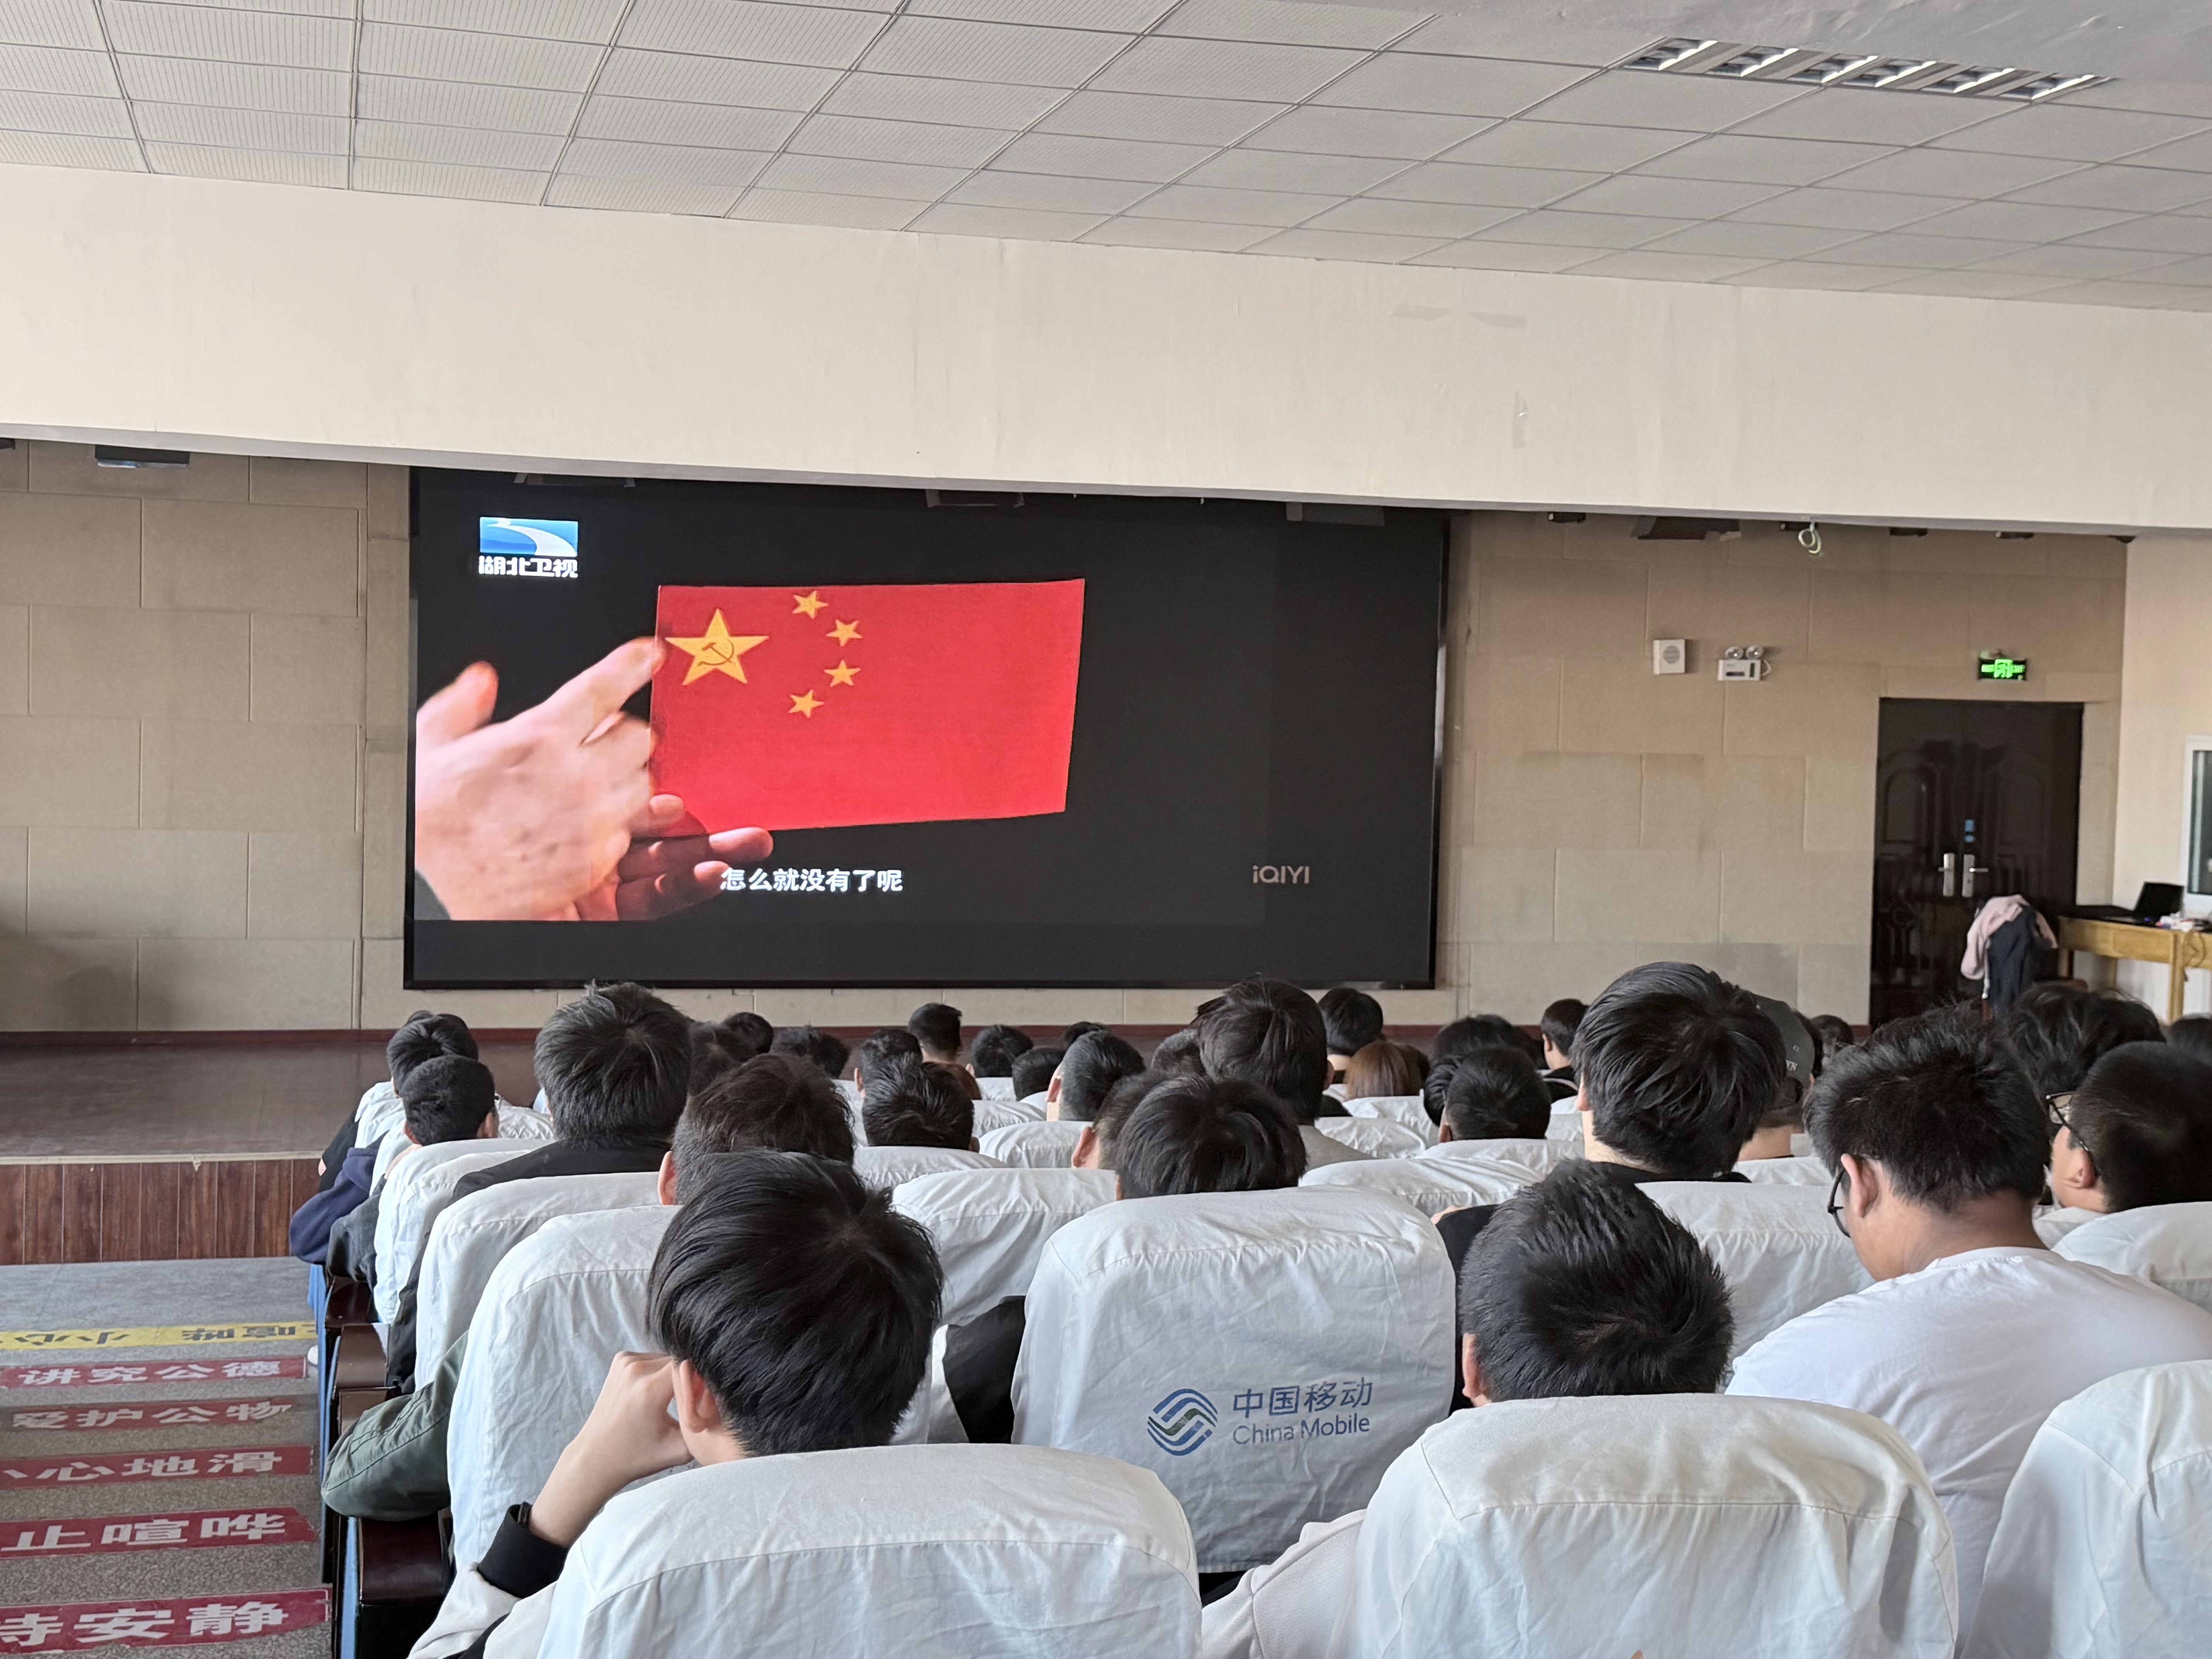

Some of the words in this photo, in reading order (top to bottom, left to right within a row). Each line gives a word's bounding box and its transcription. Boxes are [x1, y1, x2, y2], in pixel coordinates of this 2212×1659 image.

[479, 555, 578, 578] 湖北卫视
[720, 867, 903, 892] 怎么就没有了呢
[1252, 865, 1310, 884] iQIYI
[0, 1331, 130, 1346] 小心
[182, 1324, 317, 1341] 喧哗
[18, 1360, 281, 1385] 讲究公德
[1233, 1377, 1373, 1419] 中国移动
[12, 1401, 292, 1429] 爱护公物
[1233, 1423, 1294, 1445] China
[1300, 1413, 1370, 1439] Mobile
[0, 1513, 285, 1551] 止喧哗
